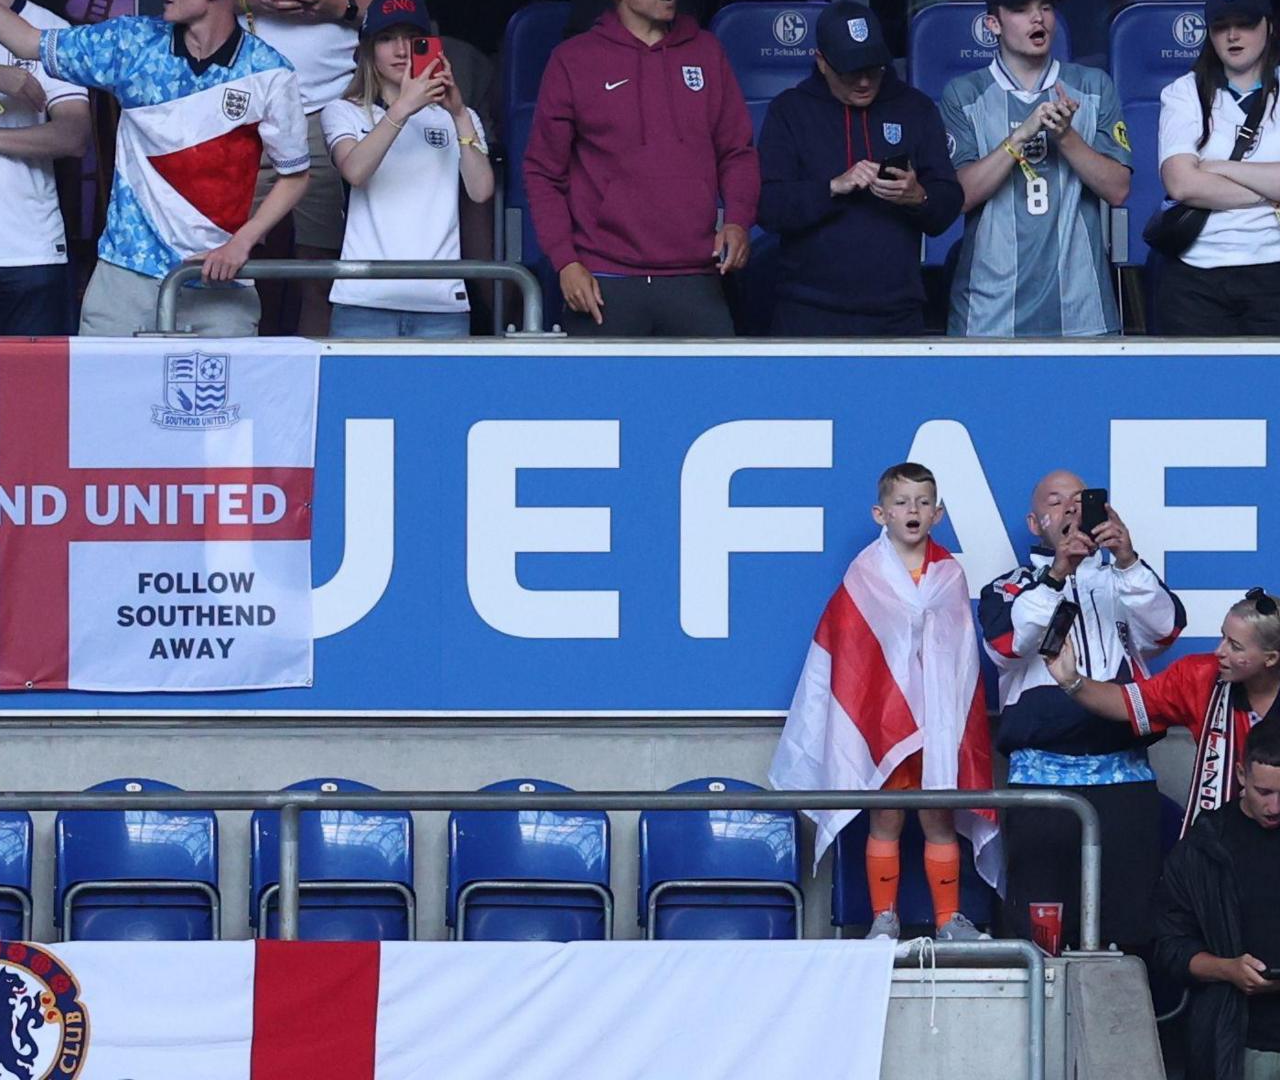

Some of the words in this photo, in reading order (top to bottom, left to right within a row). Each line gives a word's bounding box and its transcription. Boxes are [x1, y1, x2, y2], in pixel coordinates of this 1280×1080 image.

[1026, 177, 1049, 216] 8
[164, 415, 200, 426] SOUTHEND
[85, 483, 287, 526] UNITED
[137, 572, 256, 594] FOLLOW
[117, 605, 276, 628] SOUTHEND
[149, 637, 235, 660] AWAY
[59, 1011, 83, 1076] CLUB
